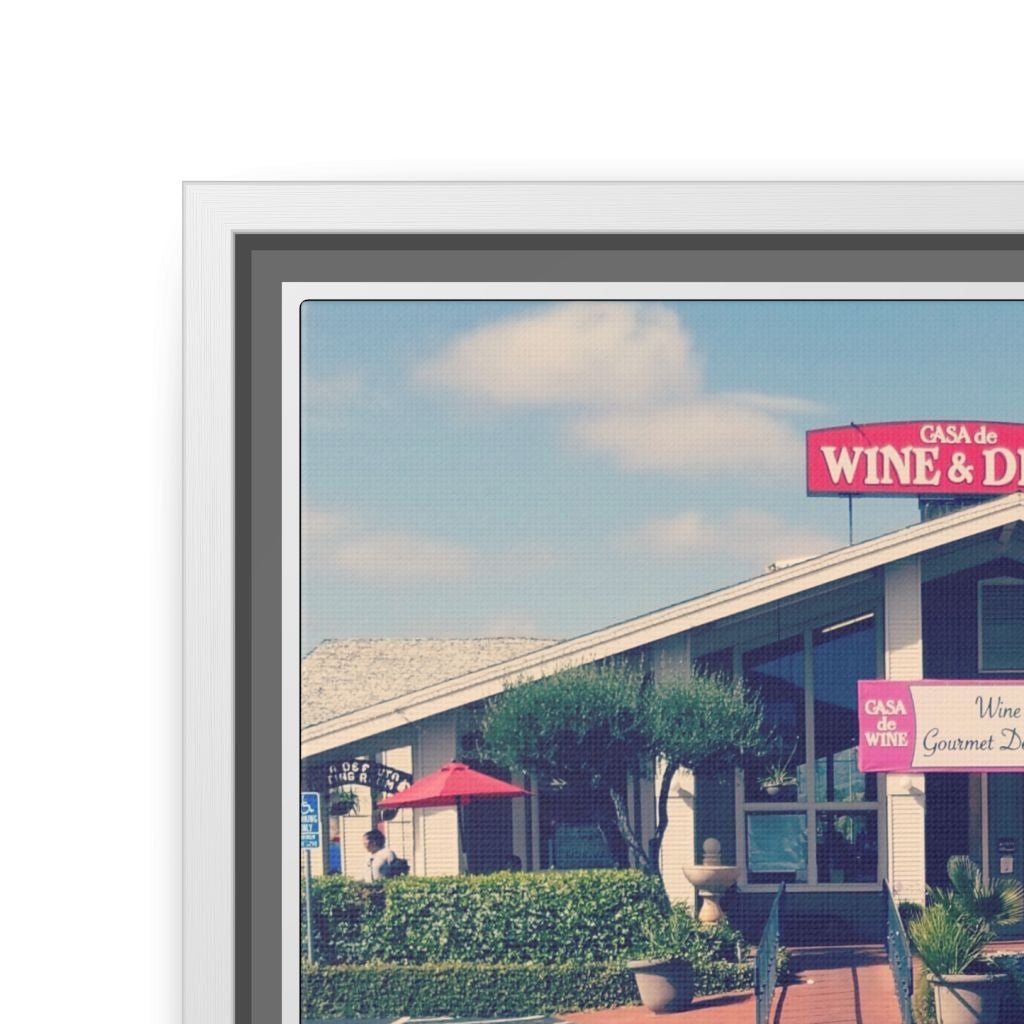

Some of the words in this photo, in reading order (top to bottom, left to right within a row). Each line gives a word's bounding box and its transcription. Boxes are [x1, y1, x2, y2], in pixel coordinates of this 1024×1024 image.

[919, 425, 970, 444] CASA
[973, 426, 998, 445] de
[820, 445, 941, 485] WINE
[947, 452, 974, 484] &
[864, 699, 907, 716] CASA
[974, 695, 1021, 718] Wine
[876, 716, 897, 731] de
[864, 731, 908, 747] WINE
[922, 727, 994, 757] Gourmet
